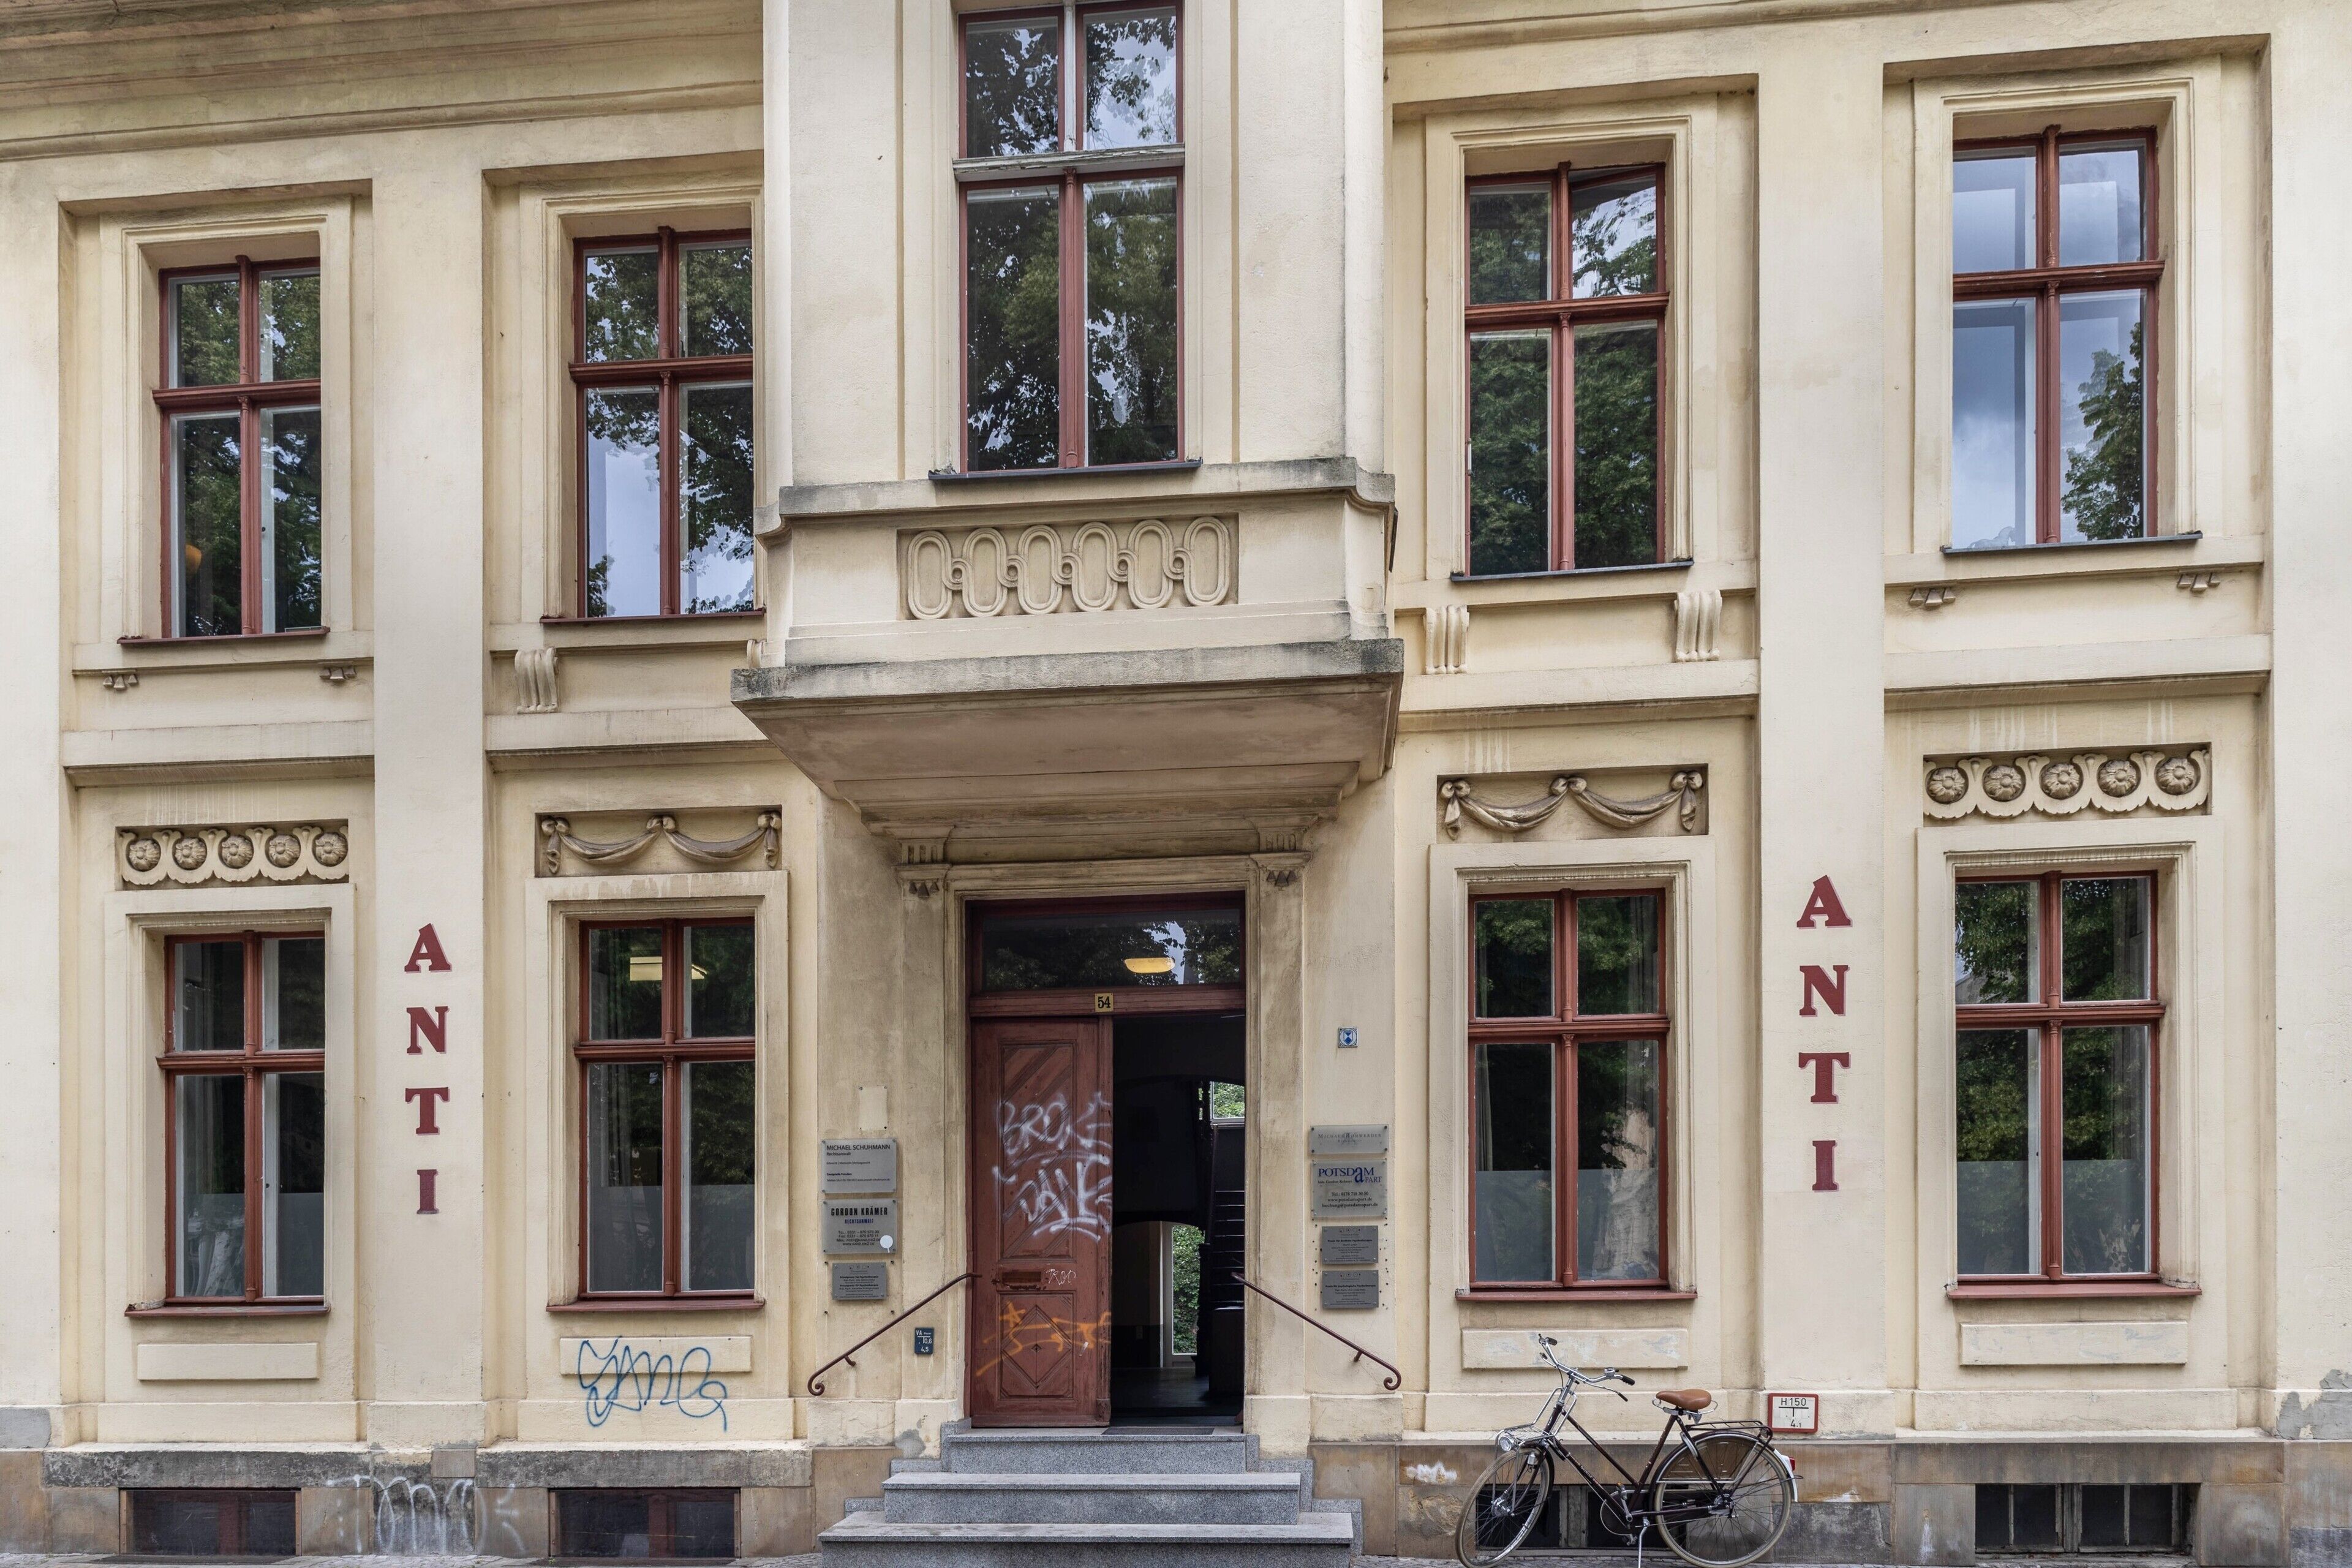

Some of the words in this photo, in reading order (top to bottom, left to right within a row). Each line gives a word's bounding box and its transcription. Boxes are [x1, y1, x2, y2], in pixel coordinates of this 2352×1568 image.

[404, 922, 452, 1215] ANTI
[1098, 996, 1110, 1009] 54
[1796, 875, 1853, 1193] ANTI
[831, 1208, 858, 1216] GORDON
[861, 1205, 888, 1216] KRÄMER
